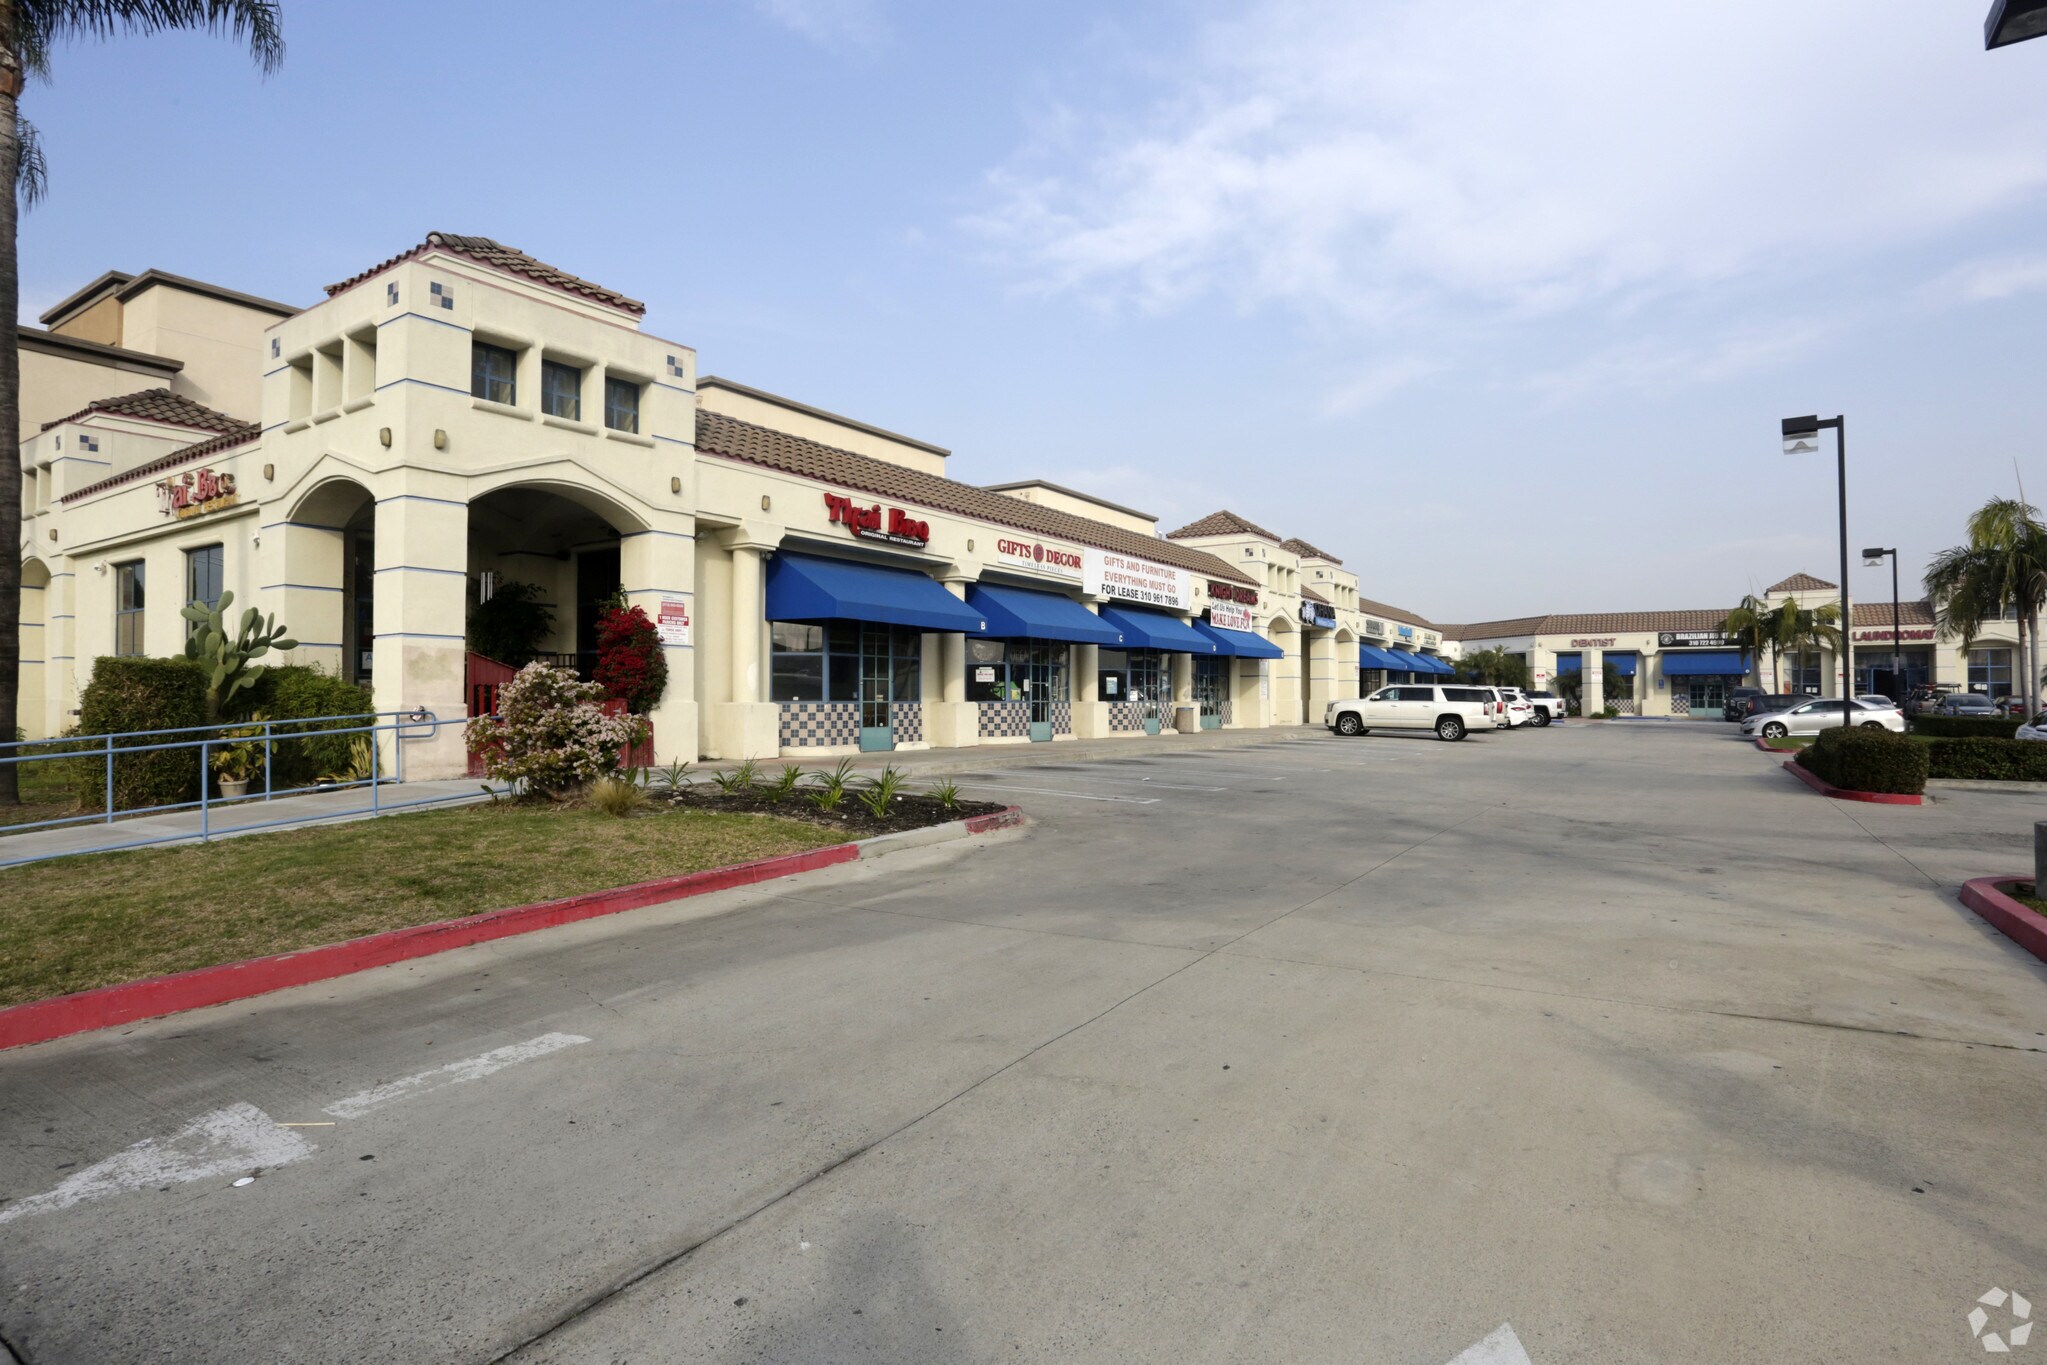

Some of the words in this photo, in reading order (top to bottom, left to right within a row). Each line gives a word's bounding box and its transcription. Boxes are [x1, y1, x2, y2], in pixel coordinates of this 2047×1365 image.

[824, 493, 881, 537] Thai
[860, 530, 888, 540] ORIGINAL
[889, 535, 925, 547] RESTAURANT
[997, 539, 1031, 558] GIFTS
[1046, 549, 1081, 569] DECOR
[1104, 556, 1124, 569] GIFTS
[1126, 561, 1140, 572] AND
[1142, 564, 1176, 580] FURNITURE
[1104, 571, 1148, 588] EVERYTHING
[1149, 580, 1166, 592] MUST
[1167, 583, 1176, 594] GO
[1101, 584, 1116, 596] FOR
[1117, 586, 1139, 600] LEASE
[1140, 590, 1152, 602] 310
[1153, 593, 1163, 603] 961
[980, 622, 986, 630] B
[1852, 629, 1937, 641] LAUNDOMAT
[1571, 637, 1616, 648] DENTIST
[1676, 632, 1708, 640] BRAZILIAN
